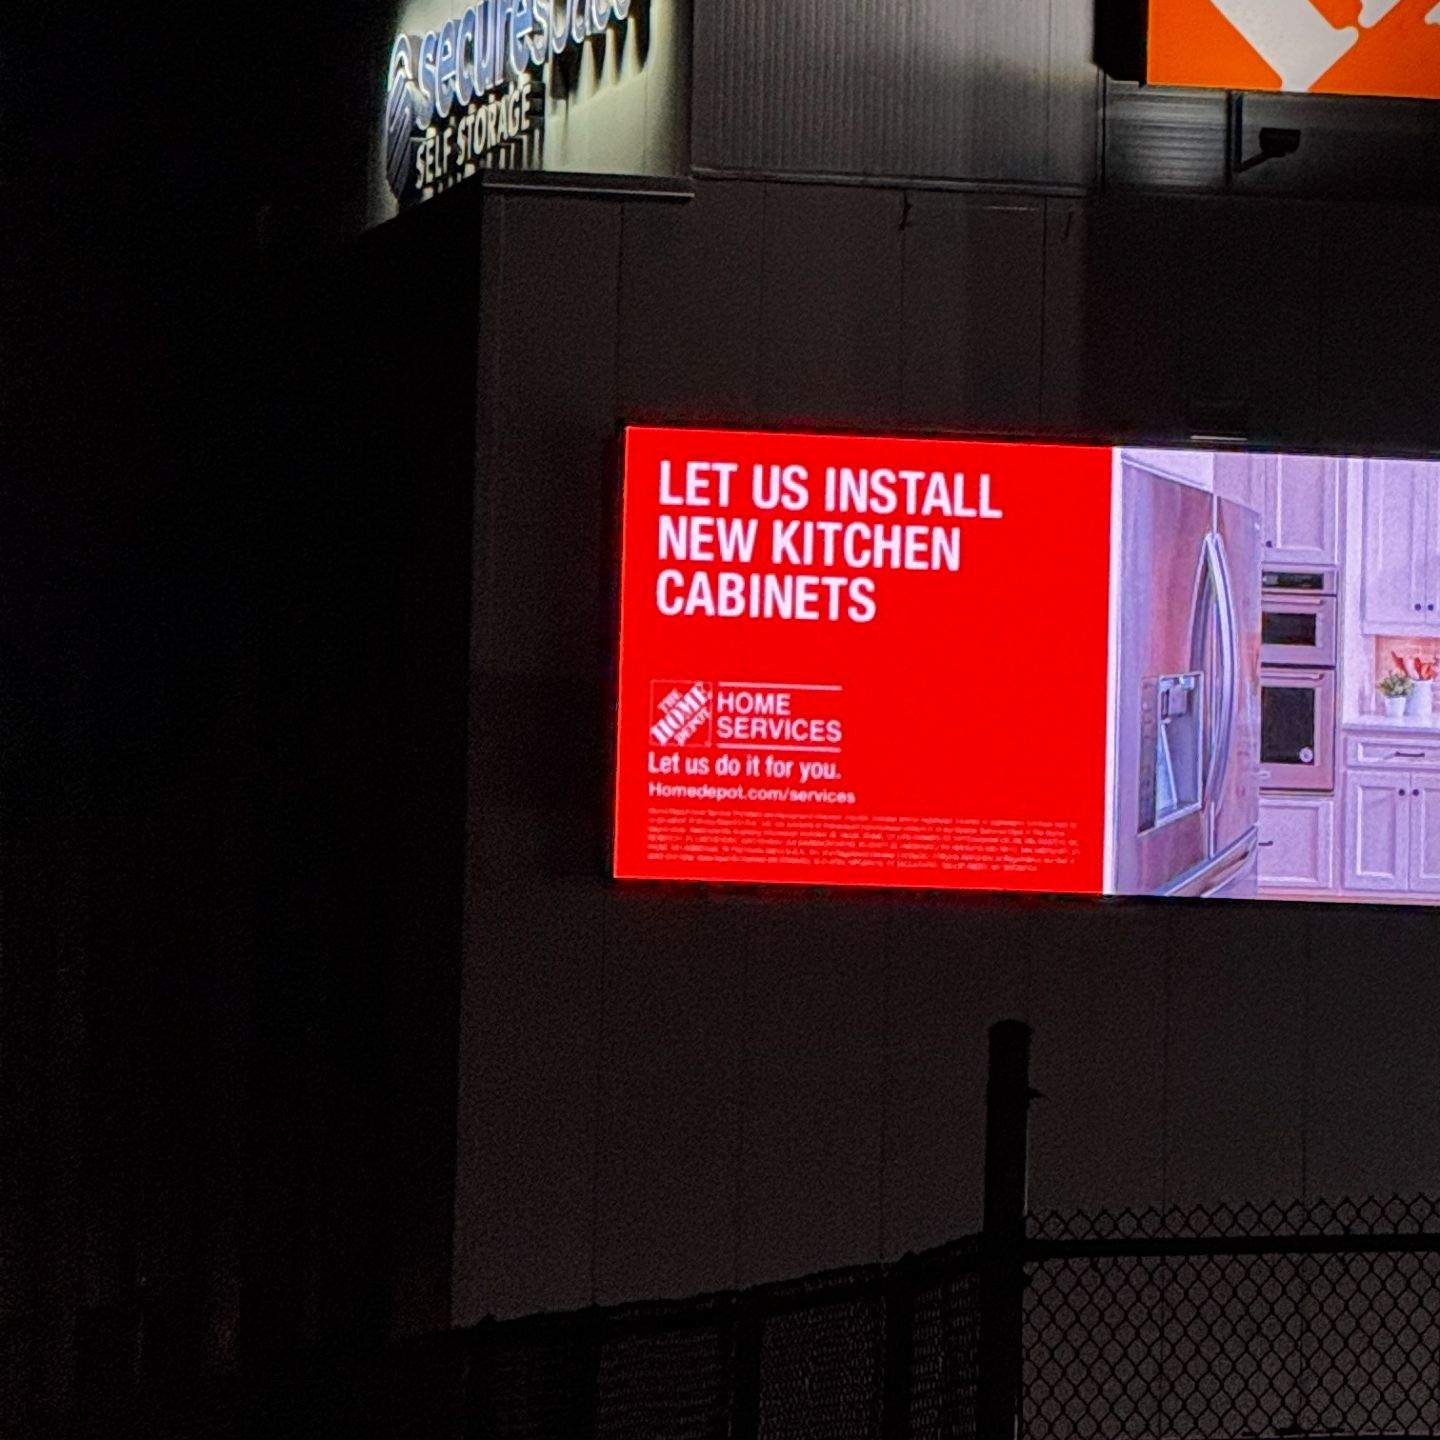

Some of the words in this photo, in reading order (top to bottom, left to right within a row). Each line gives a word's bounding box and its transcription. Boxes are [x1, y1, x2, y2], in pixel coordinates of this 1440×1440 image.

[415, 122, 453, 190] SELF
[457, 81, 532, 166] STORAGE
[658, 459, 738, 508] LET
[752, 464, 810, 512] US
[824, 467, 1003, 520] INSTALL
[657, 515, 758, 563] NEW
[771, 519, 961, 572] KITCHEN
[656, 569, 878, 623] CABINETS
[717, 691, 792, 716] HOME
[716, 716, 843, 743] SERVICES
[647, 751, 680, 775] Let
[685, 756, 710, 776] us
[715, 753, 741, 777] do
[745, 753, 761, 778] it
[765, 754, 793, 778] for
[799, 760, 842, 784] you.
[647, 781, 856, 805] Homedepot.com/services
